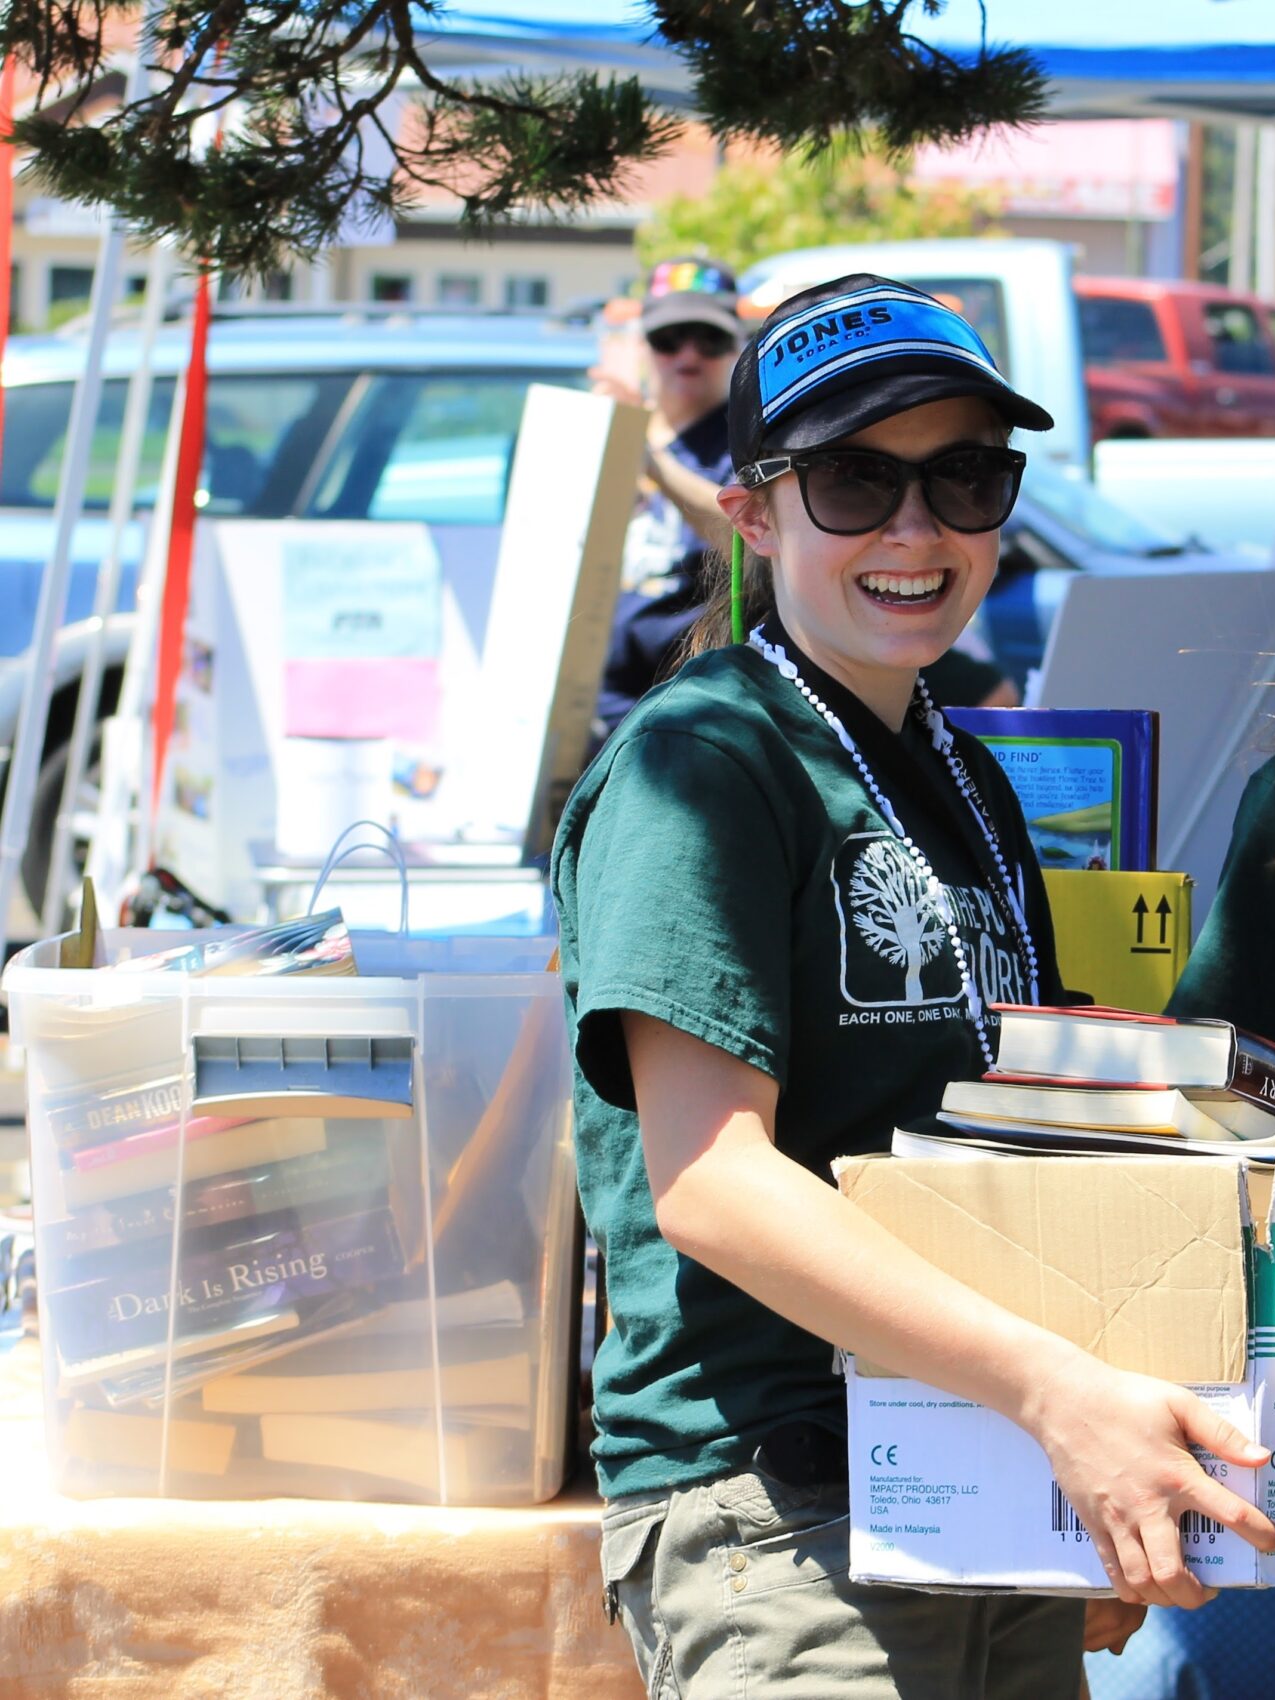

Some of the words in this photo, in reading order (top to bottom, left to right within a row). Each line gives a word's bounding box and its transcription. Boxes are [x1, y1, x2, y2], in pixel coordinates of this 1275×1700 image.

[774, 307, 892, 367] JONES
[796, 339, 839, 363] SODA
[839, 1010, 881, 1026] EACH
[884, 1008, 916, 1024] ONE,
[918, 1008, 942, 1022] ONE
[87, 1101, 141, 1130] DEAN
[114, 1280, 195, 1322] Dark
[202, 1280, 224, 1300] Is
[227, 1253, 328, 1292] Rising
[869, 1400, 887, 1408] Store
[888, 1400, 908, 1408] under
[909, 1400, 925, 1409] cool,
[926, 1401, 937, 1409] dry
[938, 1400, 976, 1409] conditions.
[871, 1445, 898, 1466] CE
[870, 1484, 904, 1494] IMPACT
[905, 1484, 959, 1495] PRODUCTS,
[961, 1485, 979, 1495] LLC
[870, 1495, 900, 1505] Toledo,
[901, 1495, 922, 1505] Ohio
[925, 1496, 951, 1505] 43617
[870, 1505, 889, 1515] USA
[870, 1524, 894, 1534] Made
[894, 1524, 903, 1534] in
[904, 1524, 941, 1536] Malaysia
[869, 1542, 895, 1552] V2000
[1184, 1554, 1203, 1565] Rev.
[1204, 1554, 1225, 1566] 9.08
